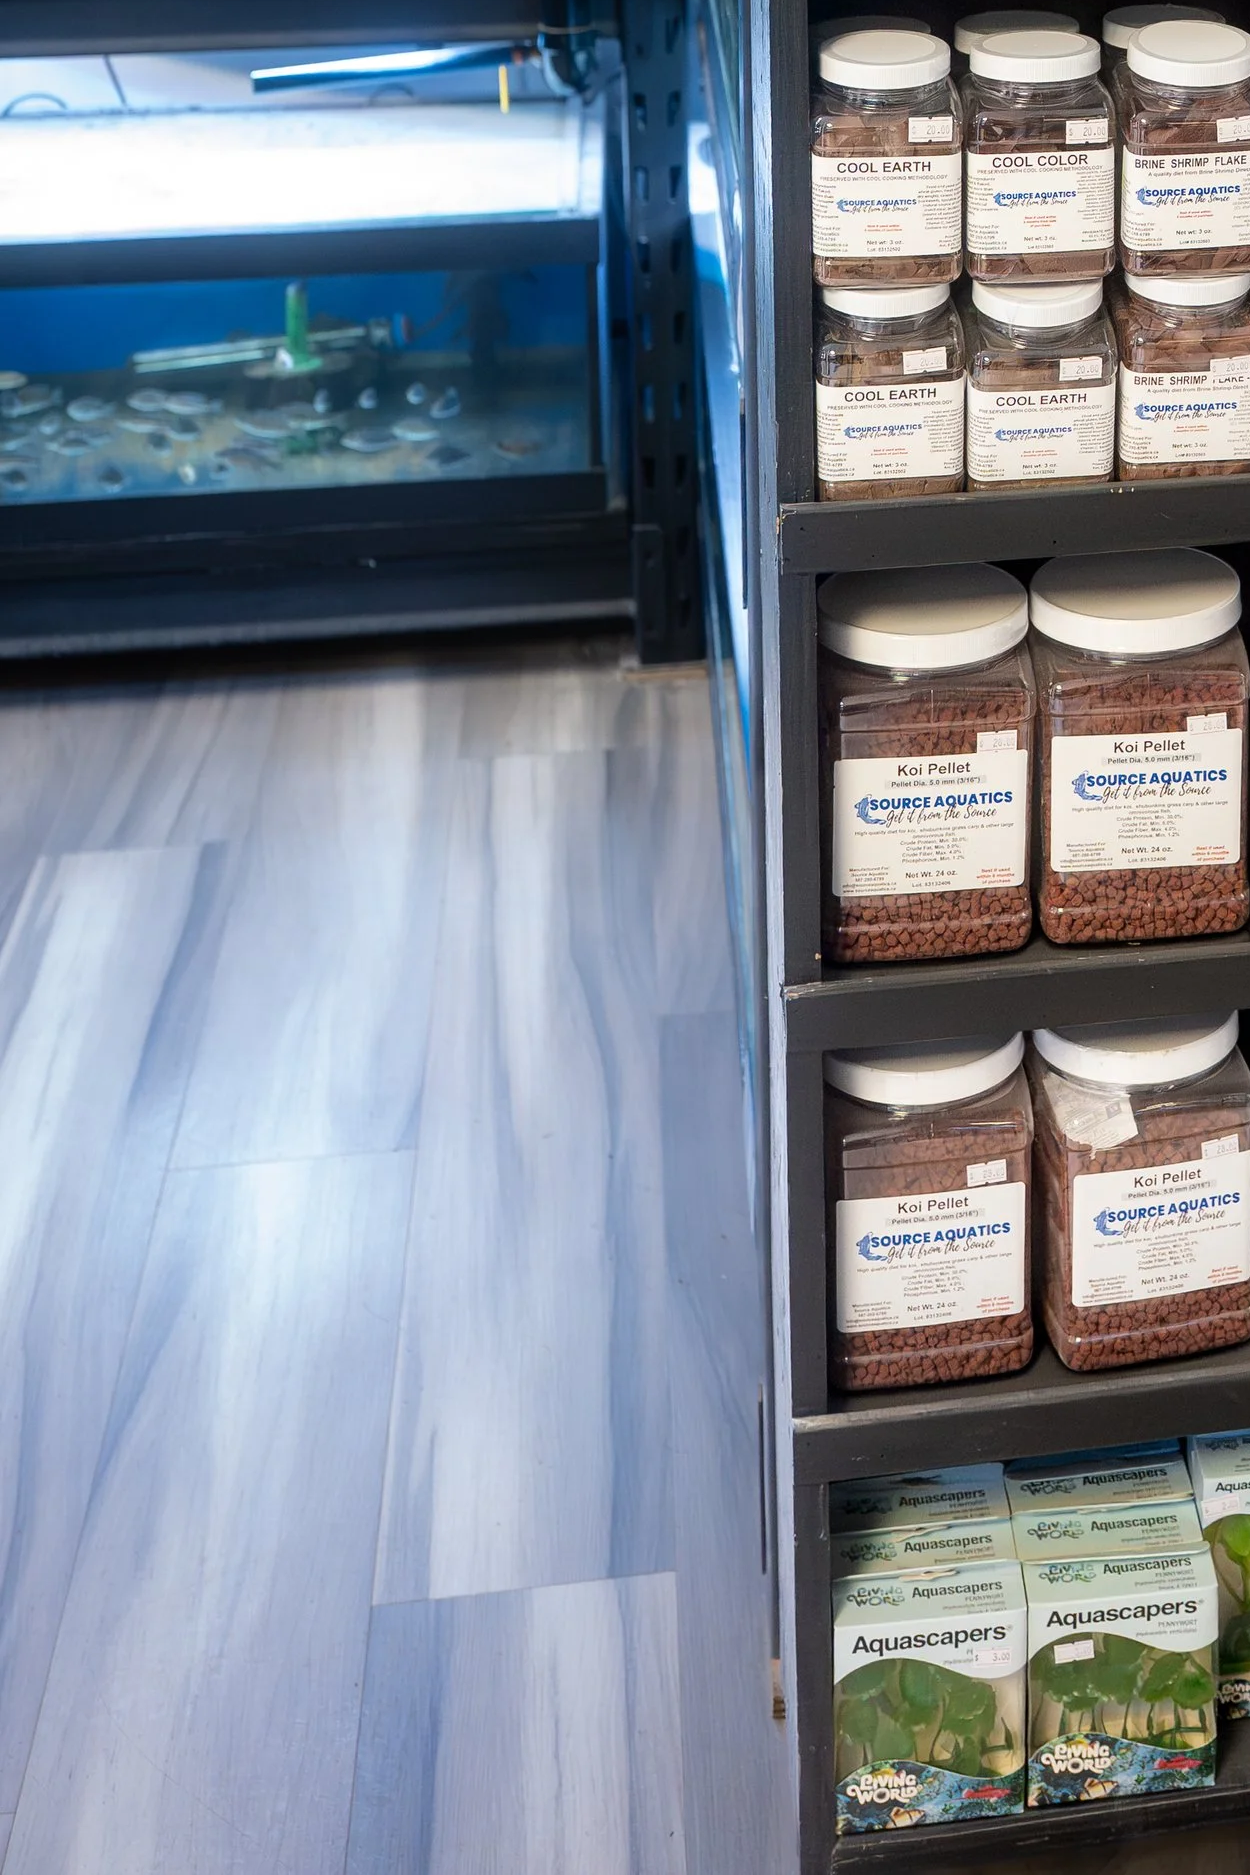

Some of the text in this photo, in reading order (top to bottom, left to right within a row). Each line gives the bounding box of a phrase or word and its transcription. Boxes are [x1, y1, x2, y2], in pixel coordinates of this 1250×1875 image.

[836, 161, 931, 173] COOL EARTH
[992, 154, 1088, 169] COOL COLOR
[1134, 159, 1165, 169] BRINE
[1171, 157, 1209, 168] SHRIMP
[1214, 155, 1248, 166] FLAKE
[1146, 185, 1240, 197] SOURCE AQUATICS
[844, 387, 936, 402] COOL EARTH
[897, 760, 971, 777] Koi Pellet
[870, 791, 1013, 811] SOURCE AQUATICS
[905, 871, 918, 879] Net
[920, 870, 934, 879] Wt.
[936, 870, 945, 878] 24
[897, 1196, 969, 1215] Koi Pellet
[1107, 1192, 1241, 1223] SOURCE AQUATICS
[912, 1580, 1003, 1600] Aquascapers
[1046, 1599, 1198, 1630] Aquascapers
[851, 1624, 1006, 1658] Aquascapers
[993, 1652, 1011, 1662] 3.00
[1041, 1753, 1113, 1774] WORLD
